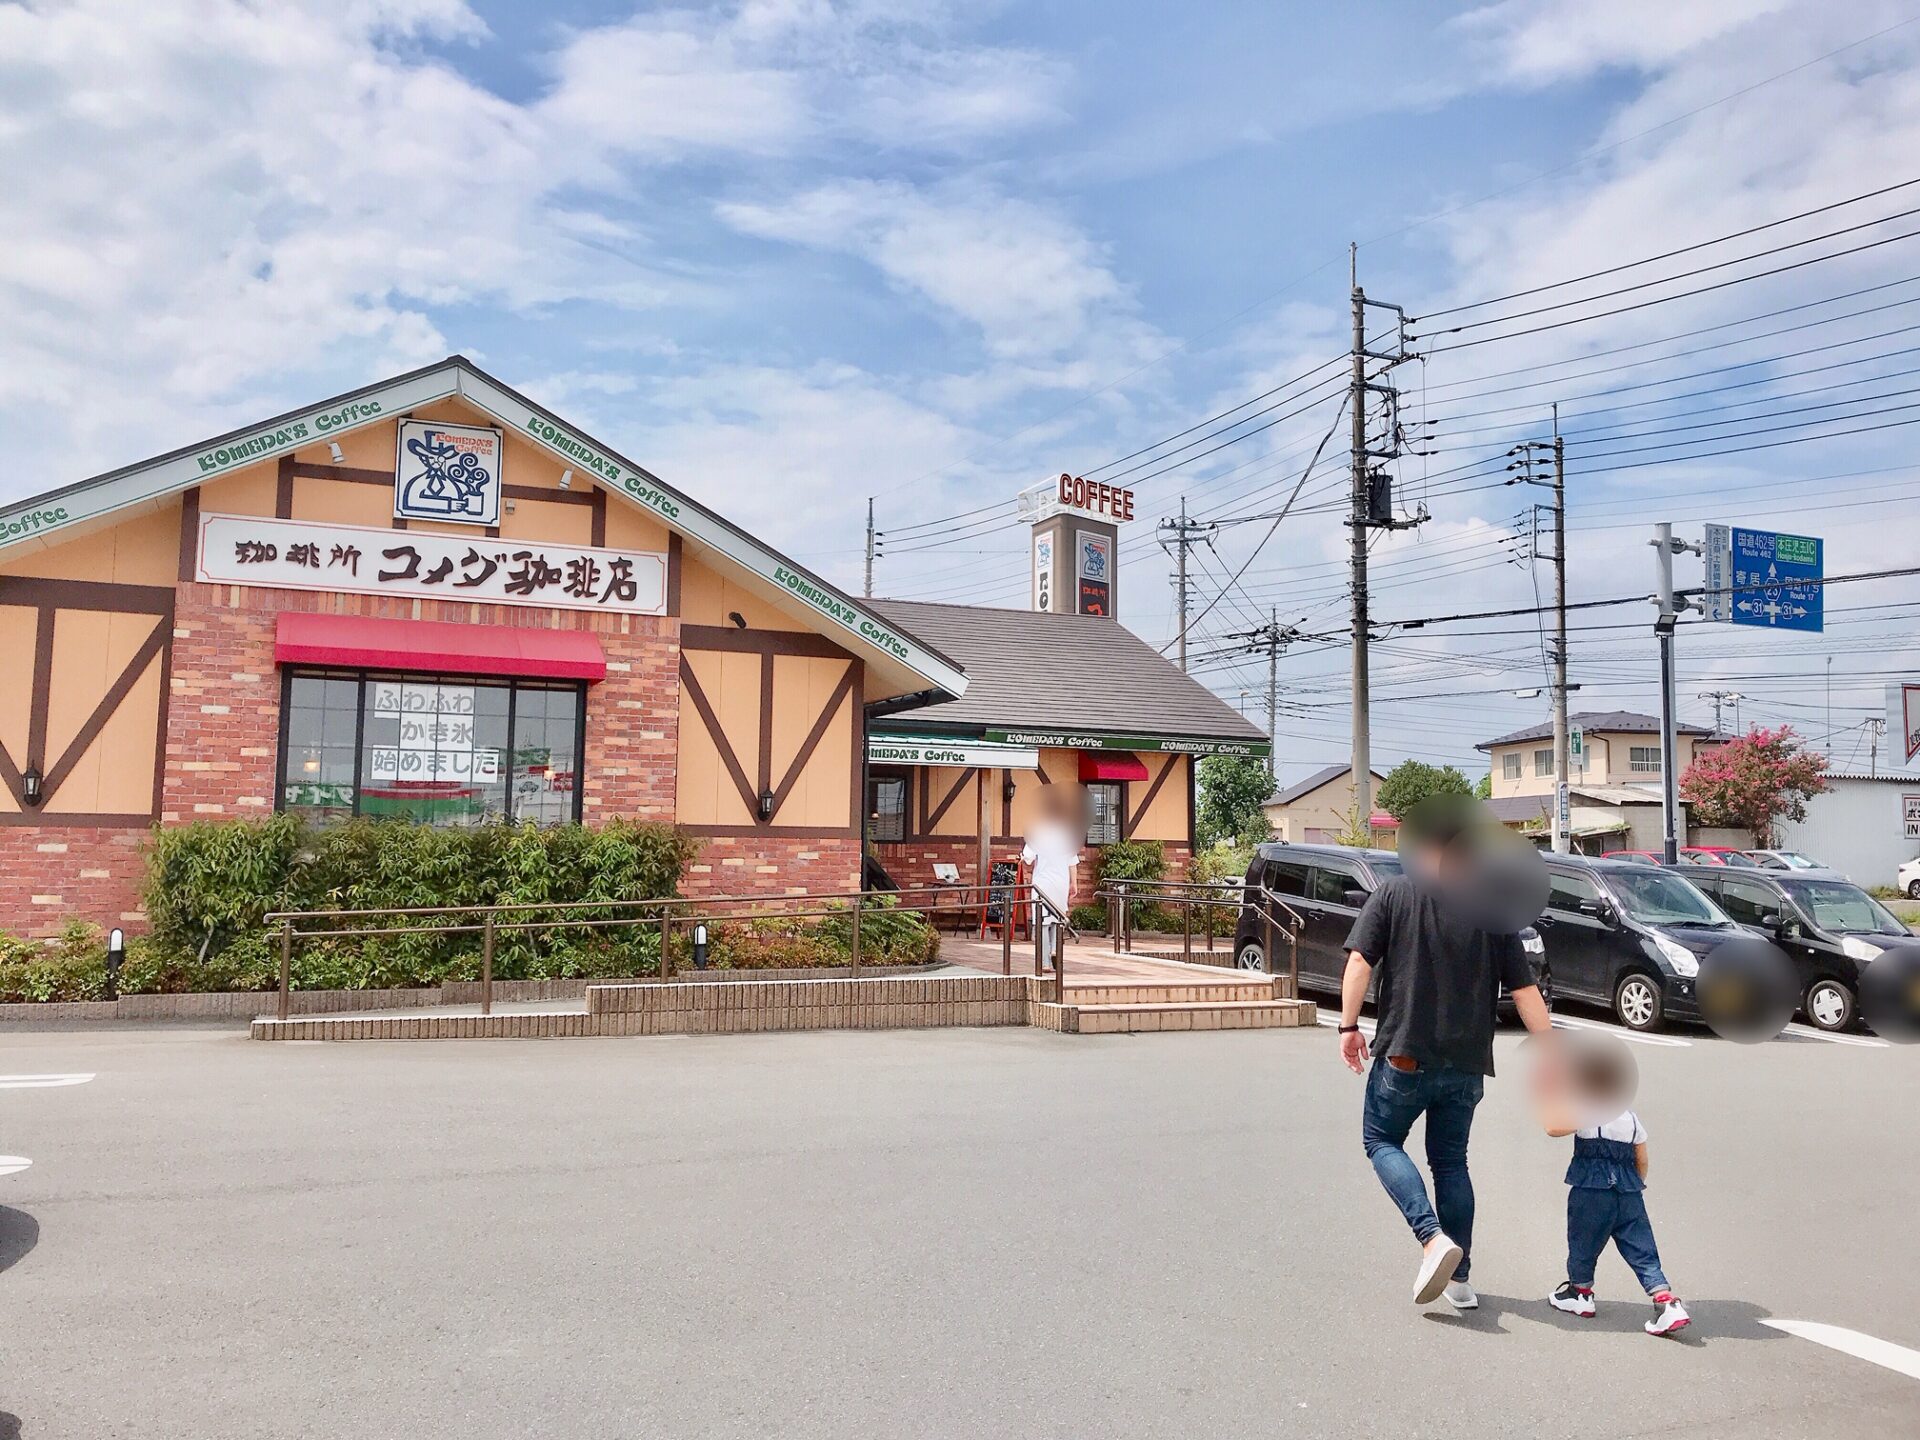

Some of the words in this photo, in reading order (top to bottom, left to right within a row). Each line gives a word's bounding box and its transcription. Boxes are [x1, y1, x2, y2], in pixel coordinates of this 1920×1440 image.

[197, 412, 309, 472] KOMEDA'S
[315, 401, 382, 431] Coffee
[435, 433, 494, 448] KOMEDA'S
[455, 444, 493, 456] Coffee
[526, 417, 621, 480] KOMEDA'S
[624, 477, 680, 518] Coffee
[1059, 473, 1134, 520] COFFEE
[1737, 532, 1775, 550] 国道462号
[1777, 538, 1815, 555] 本庄児玉IC
[1742, 548, 1758, 558] Route
[1760, 550, 1772, 559] 462
[235, 541, 362, 577] 珈琲所
[378, 546, 638, 604] コメダ珈琲店
[1790, 591, 1806, 600] Route
[1807, 593, 1815, 601] 17
[773, 567, 857, 625] KOMEDA'S
[859, 621, 909, 658] Coffee
[1753, 602, 1763, 614] 31
[1783, 606, 1792, 616] 31
[376, 689, 474, 713] ふわふわ
[401, 720, 474, 744] かき氷
[1007, 733, 1065, 746] KOMEDA'S
[1068, 736, 1103, 747] Coffee
[868, 747, 920, 760] MEDA'S
[924, 750, 966, 762] Coffee
[1160, 740, 1215, 753] KOMEDA'S
[1217, 743, 1251, 755] Coffee
[373, 750, 497, 775] 始めました
